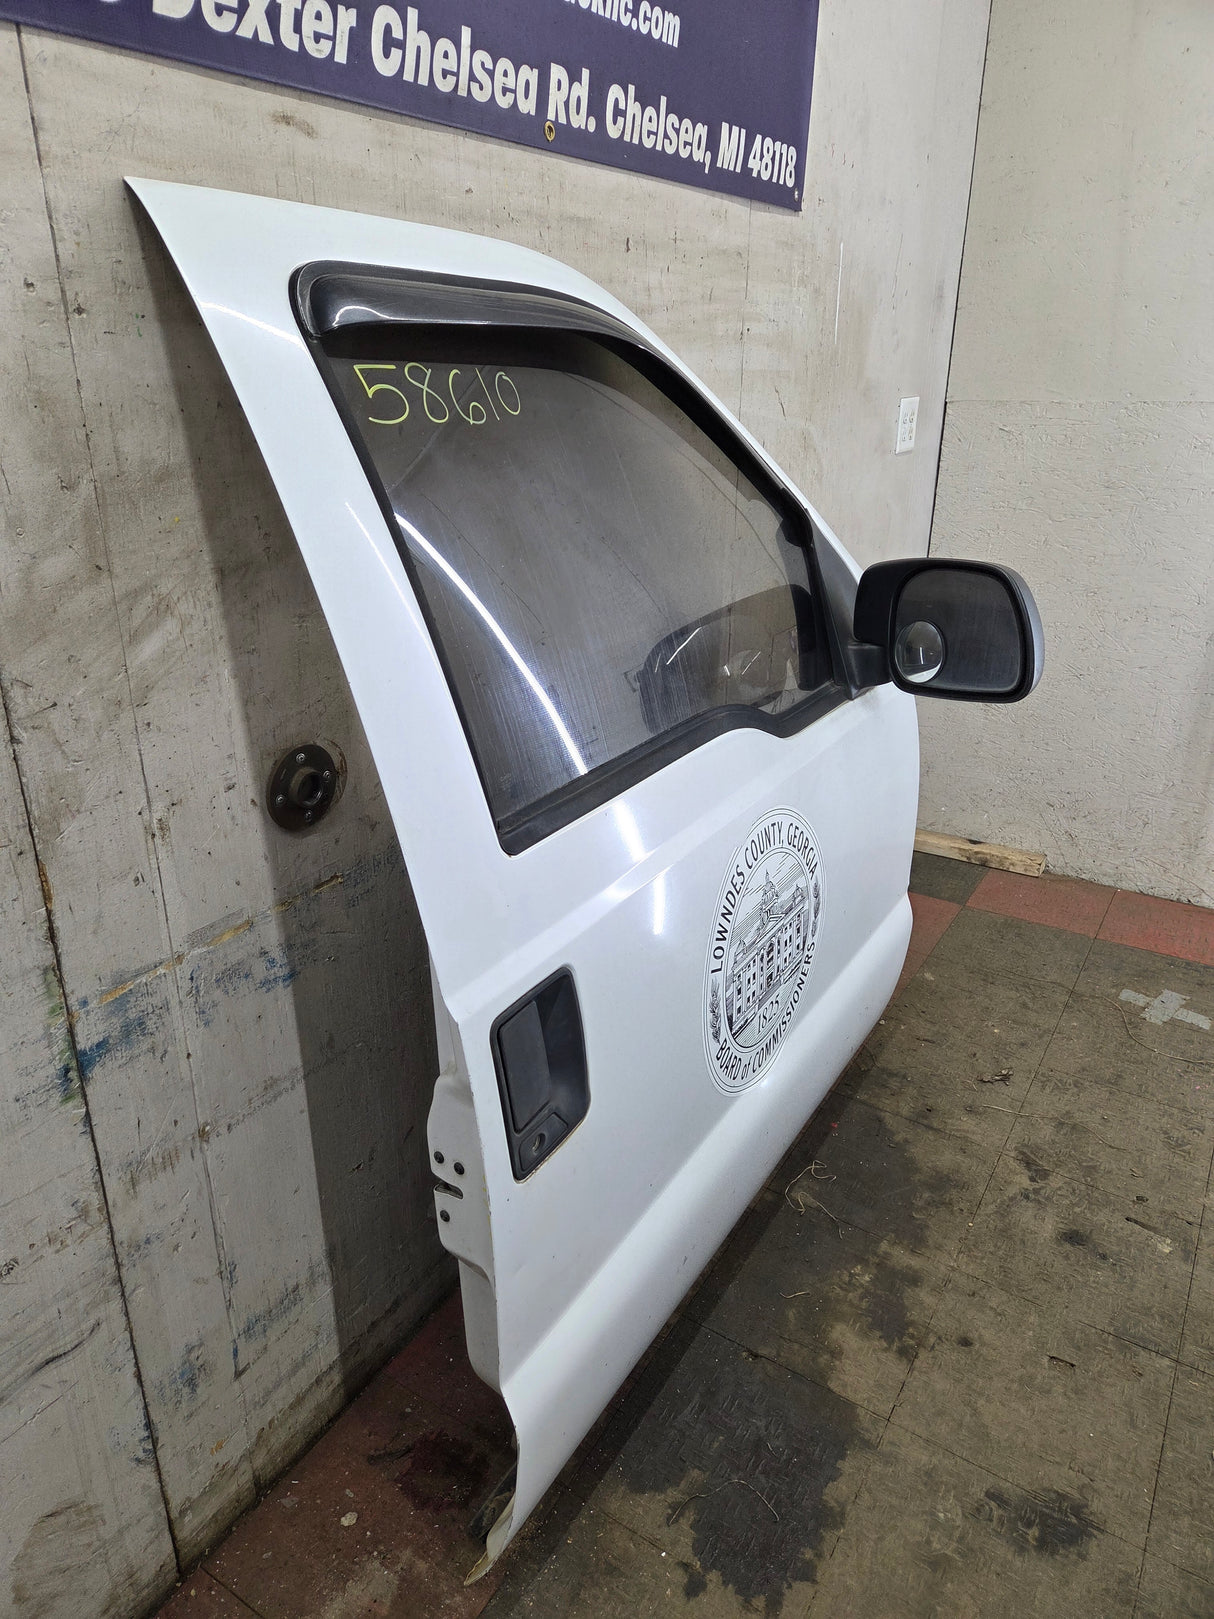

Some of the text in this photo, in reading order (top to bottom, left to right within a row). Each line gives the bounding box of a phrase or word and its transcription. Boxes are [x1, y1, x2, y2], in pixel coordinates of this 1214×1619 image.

[152, 0, 797, 188] exter Chelsea Rd. Chelsea, MI 48118
[353, 362, 521, 425] 58610
[711, 864, 746, 974] LOWNDES
[787, 822, 818, 880] GEORGIA
[716, 941, 816, 1080] BOARD of COMMISSIONERS
[757, 993, 780, 1034] 1825
